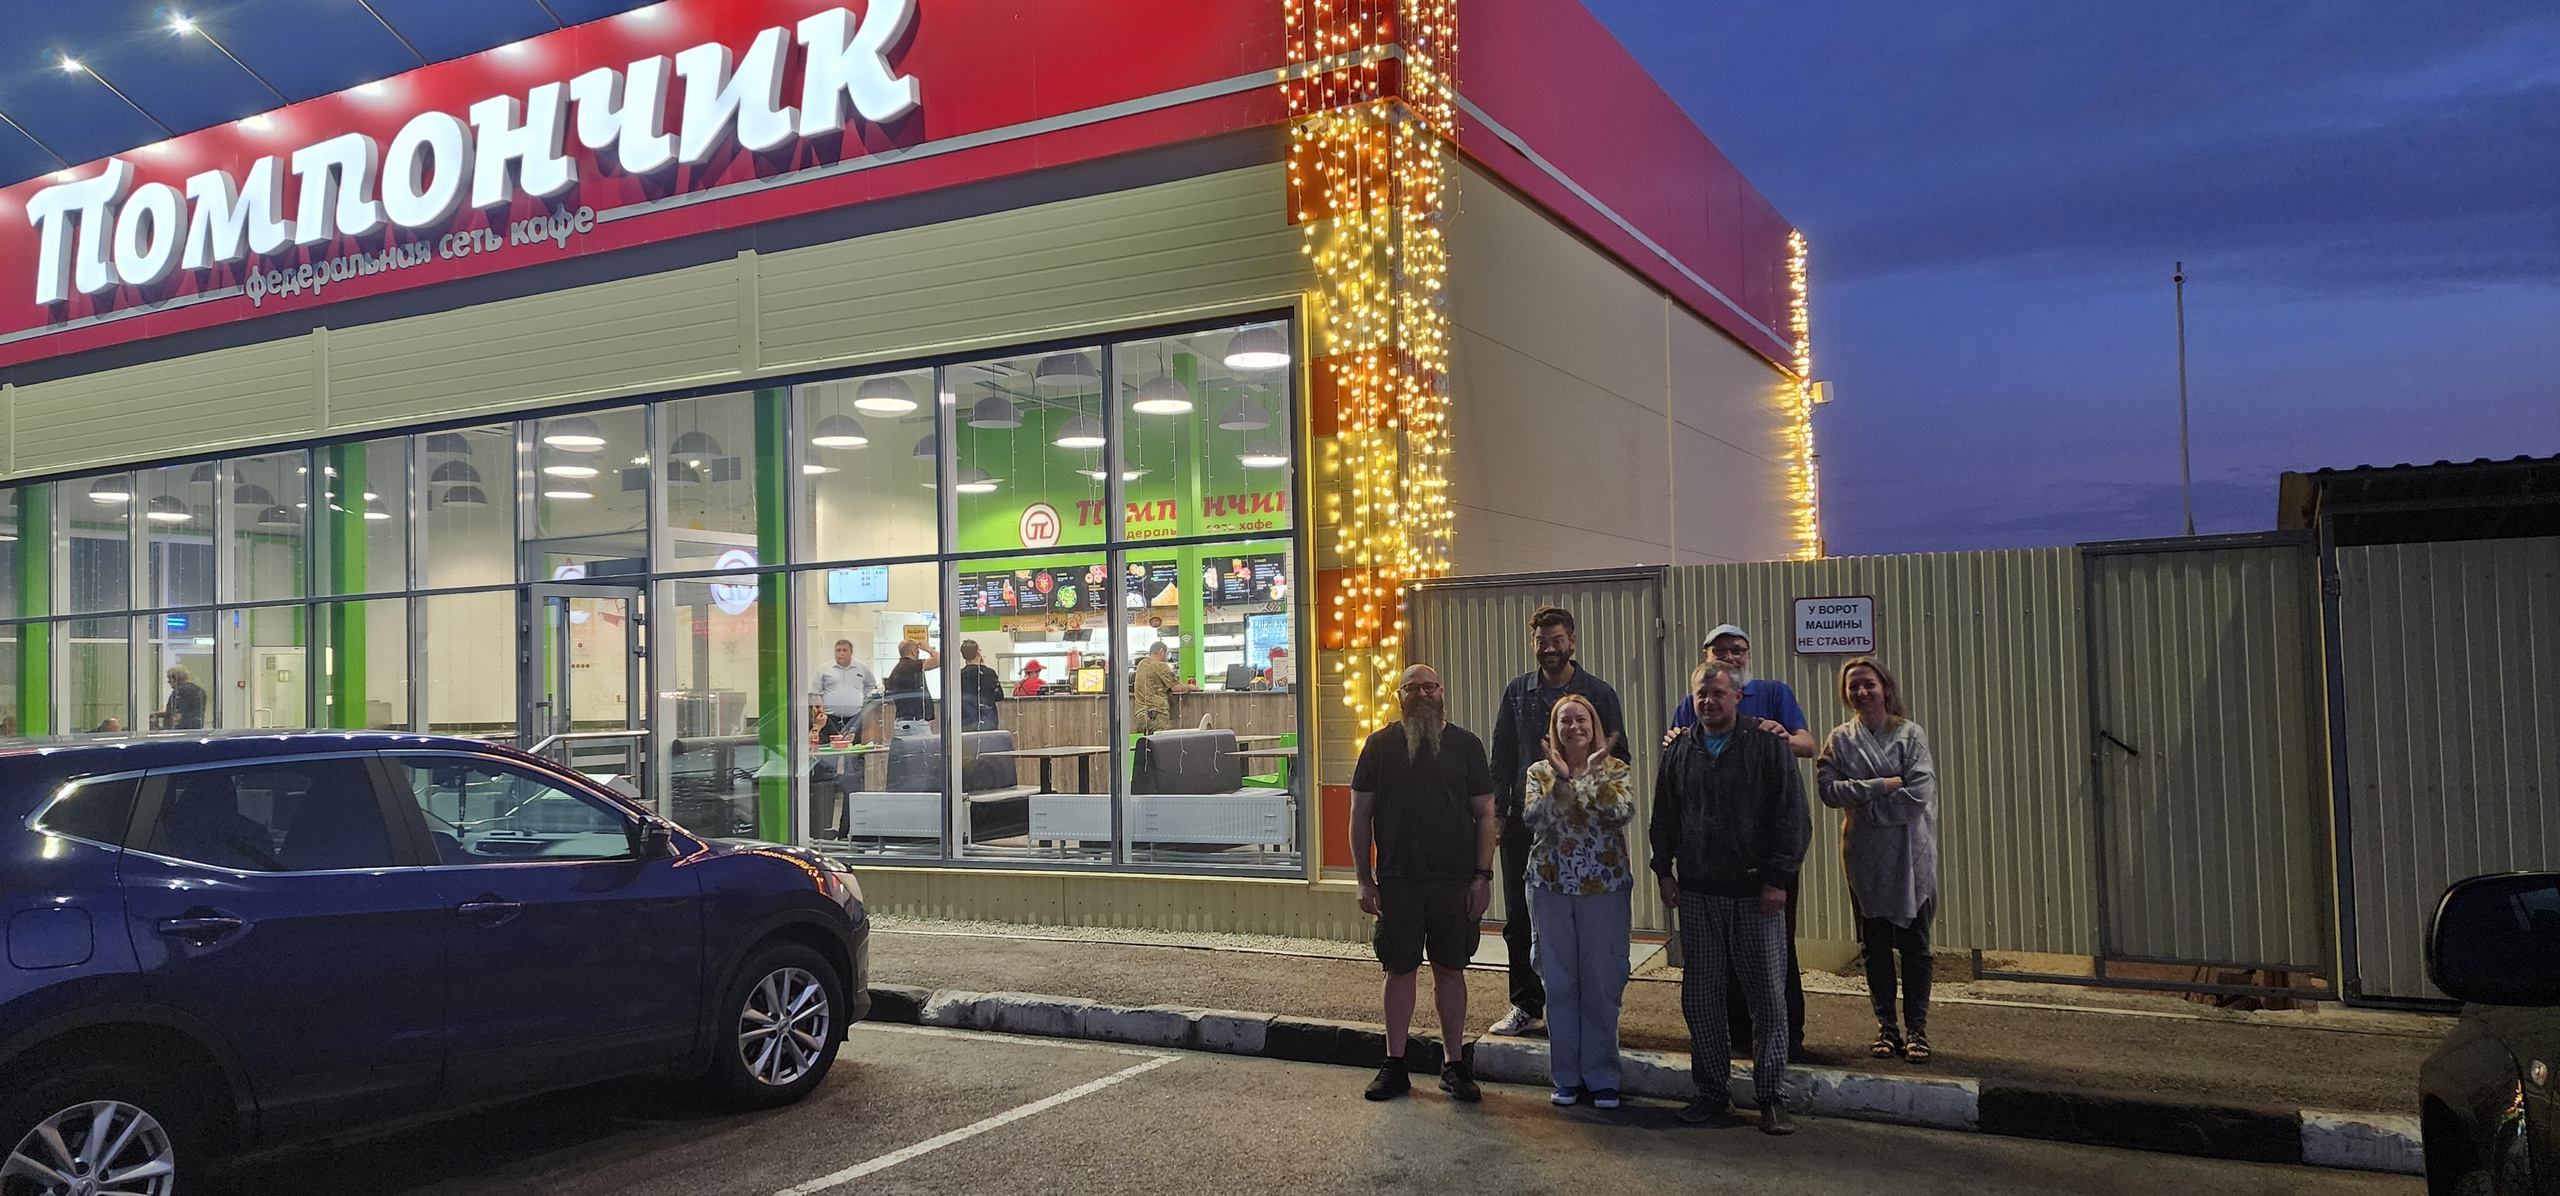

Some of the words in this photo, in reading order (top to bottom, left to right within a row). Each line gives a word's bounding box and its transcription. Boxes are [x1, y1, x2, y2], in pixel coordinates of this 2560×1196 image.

[26, 0, 921, 305] Помпончик
[245, 239, 431, 307] федеральная
[438, 227, 502, 261] сеть
[511, 202, 594, 249] кафе
[1239, 518, 1273, 532] кафе
[1808, 605, 1816, 615] У
[1818, 604, 1859, 614] ВОРОТ
[1805, 619, 1862, 630] МАШИНЫ
[1798, 637, 1814, 646] НЕ
[1816, 636, 1871, 646] СТАВИТЬ
